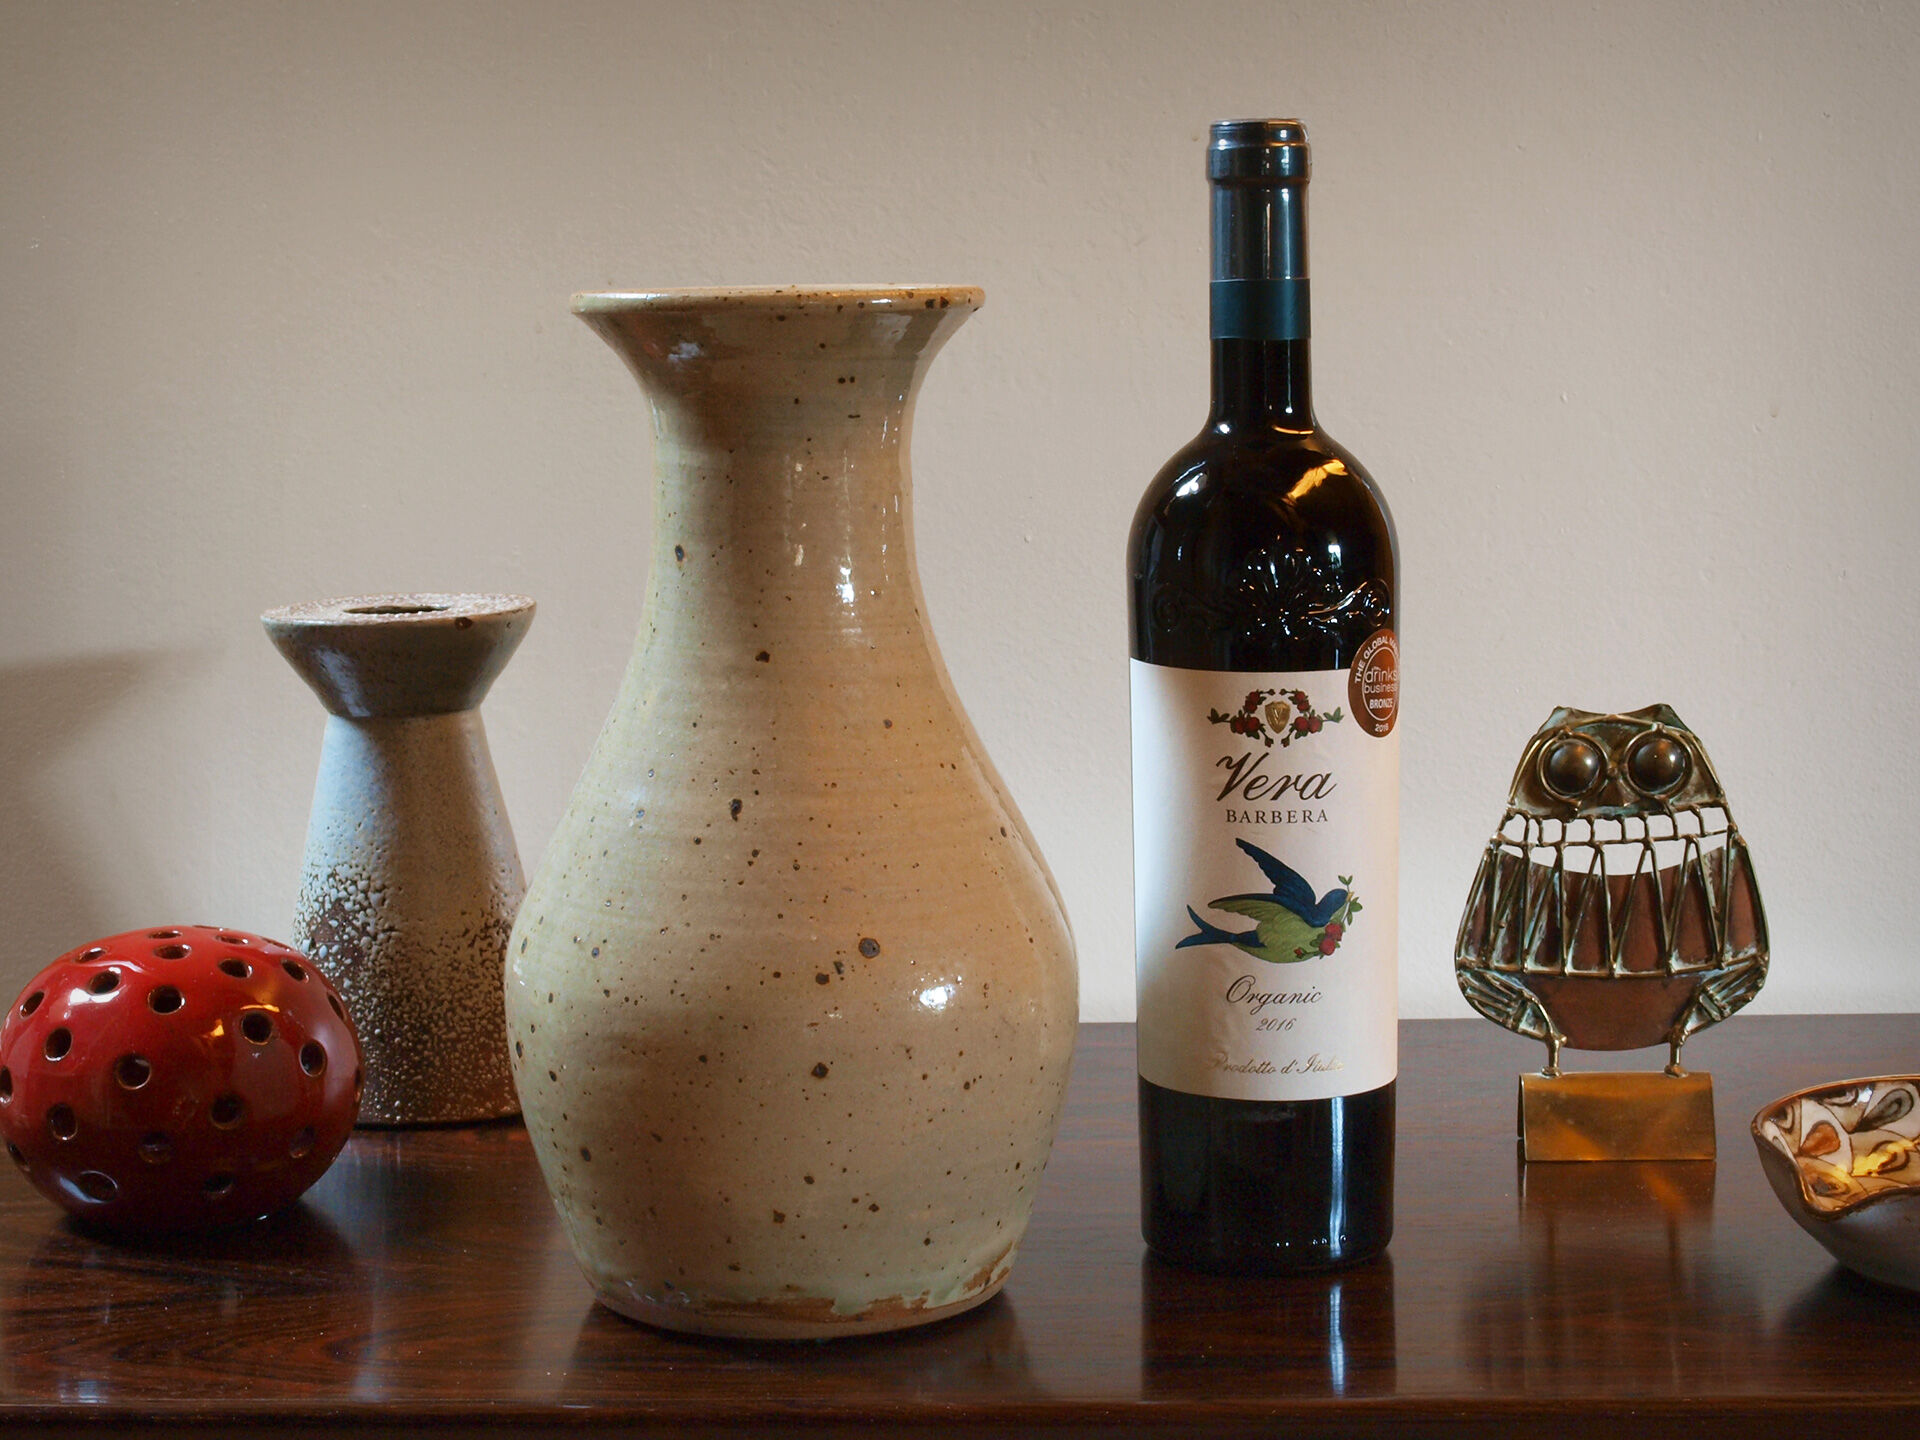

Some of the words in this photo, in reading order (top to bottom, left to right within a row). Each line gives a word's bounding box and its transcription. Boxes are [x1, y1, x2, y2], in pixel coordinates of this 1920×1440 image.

[1355, 660, 1366, 683] THE
[1364, 637, 1388, 658] GLOBAL
[1365, 668, 1397, 683] drinks
[1369, 699, 1393, 709] BRONZE
[1216, 752, 1337, 801] Vera
[1226, 809, 1328, 823] BARBERA
[1226, 975, 1323, 1015] Organic
[1256, 1018, 1297, 1031] 2016
[1206, 1051, 1275, 1074] Prodotto
